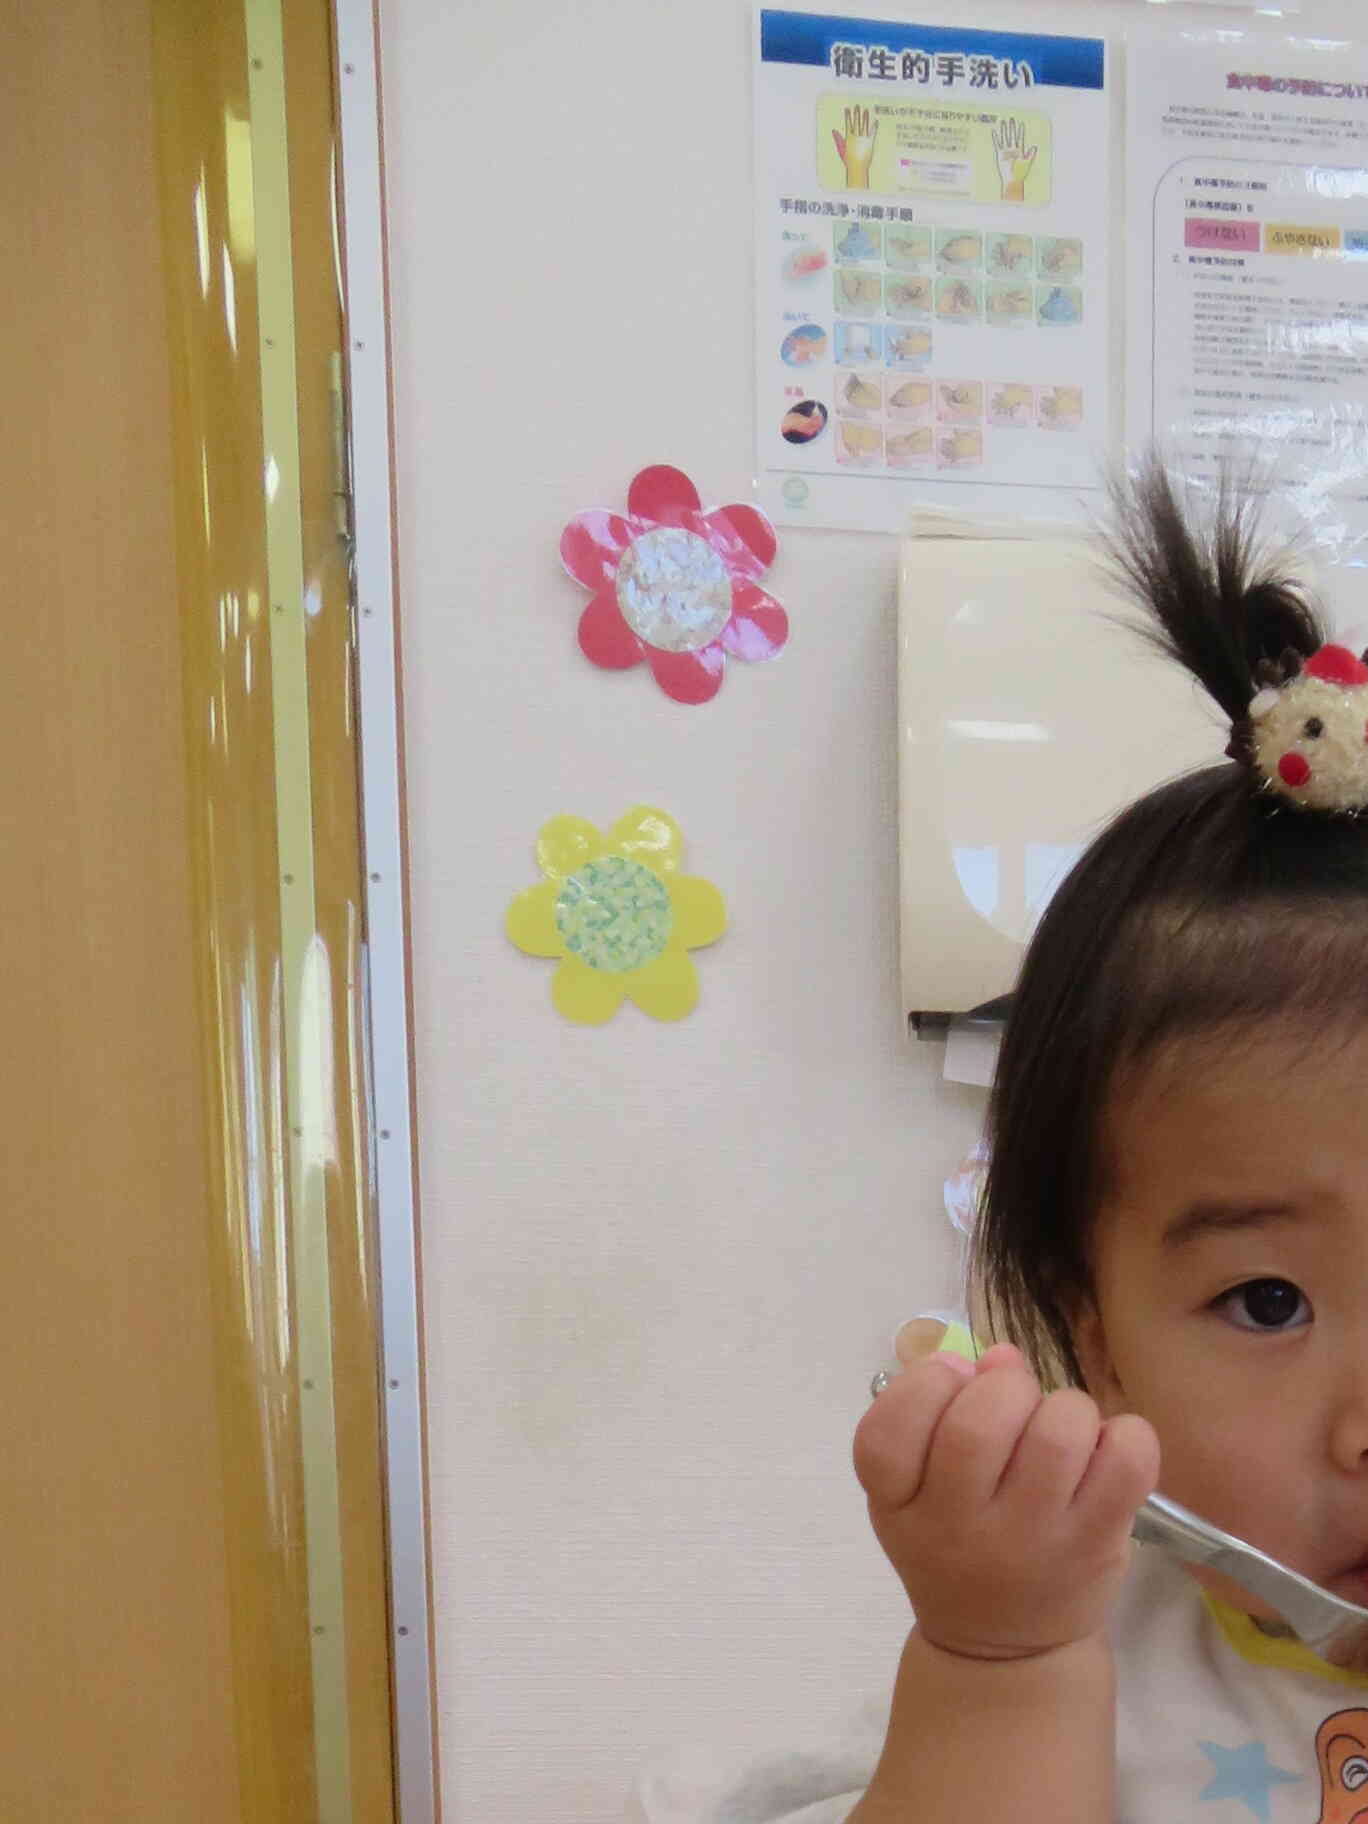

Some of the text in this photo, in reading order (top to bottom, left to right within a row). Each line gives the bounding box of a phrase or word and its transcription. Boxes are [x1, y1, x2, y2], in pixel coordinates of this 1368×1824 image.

[833, 44, 1031, 89] 衛生的手洗い
